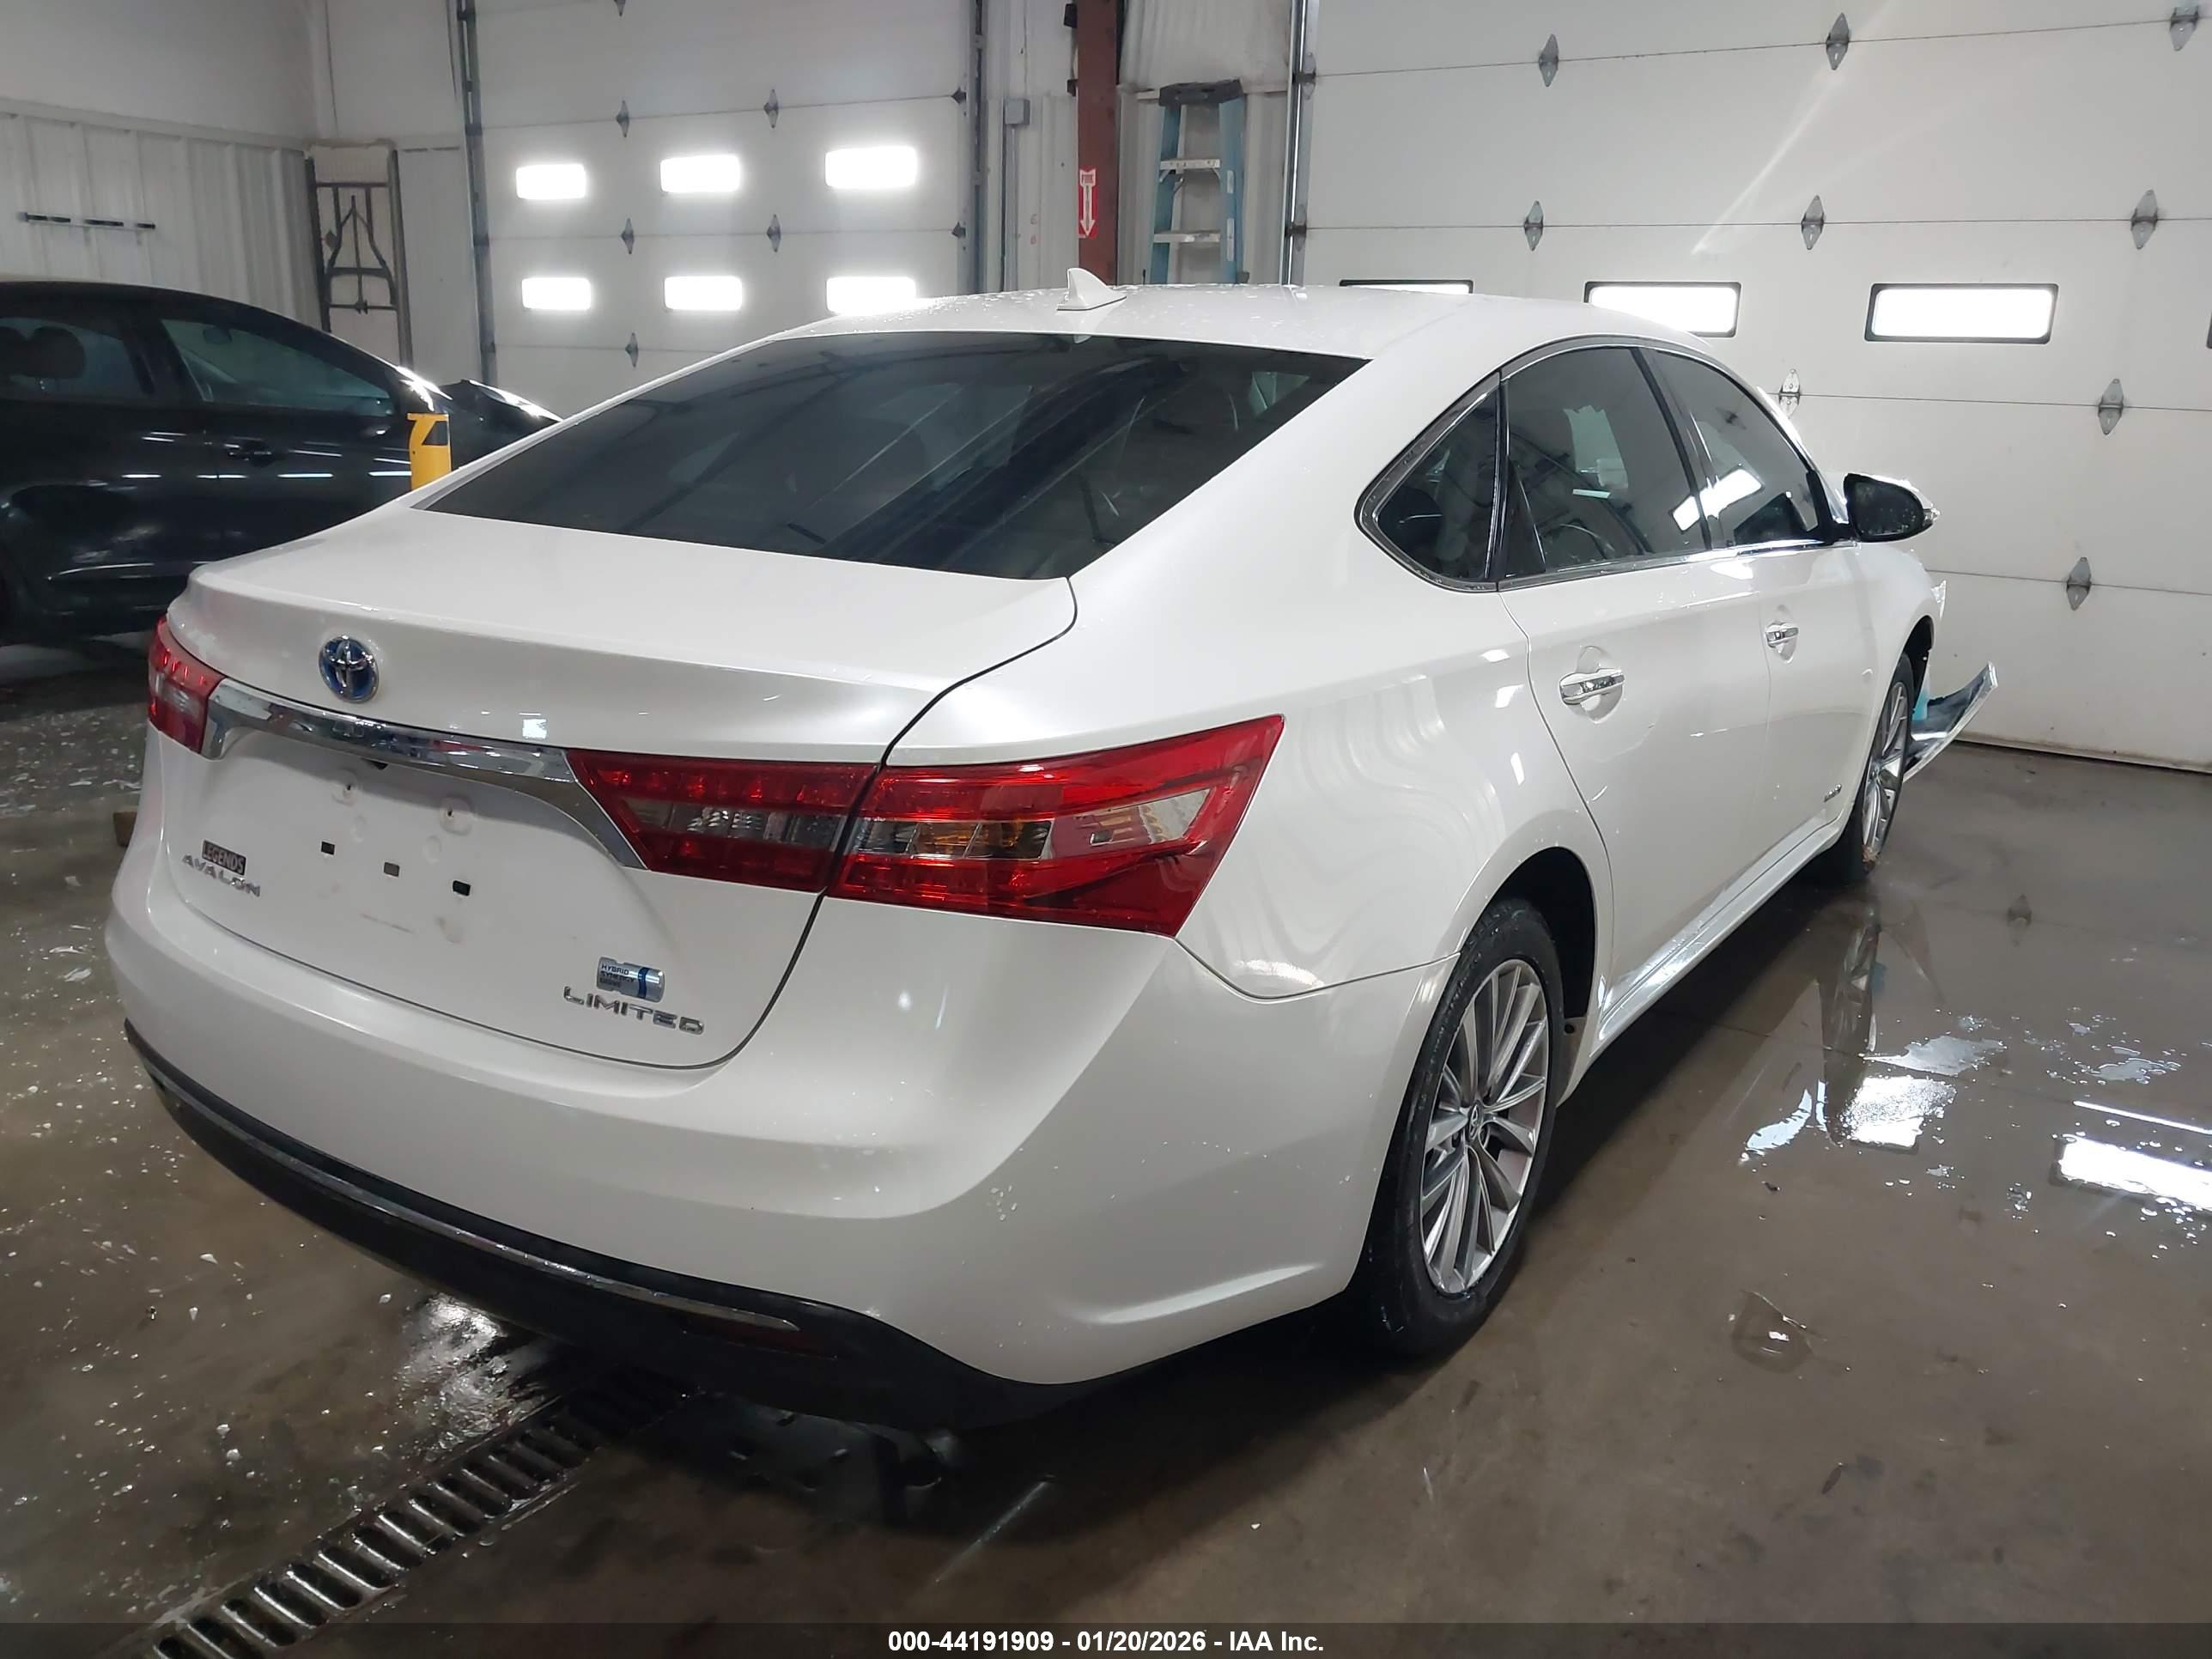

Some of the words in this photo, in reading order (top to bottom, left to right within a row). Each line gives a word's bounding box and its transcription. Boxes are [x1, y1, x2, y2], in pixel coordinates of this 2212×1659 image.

[182, 854, 260, 897] AVALON
[203, 842, 245, 874] LEGENDS
[601, 963, 629, 975] HYBRID
[563, 986, 704, 1035] LIMITED
